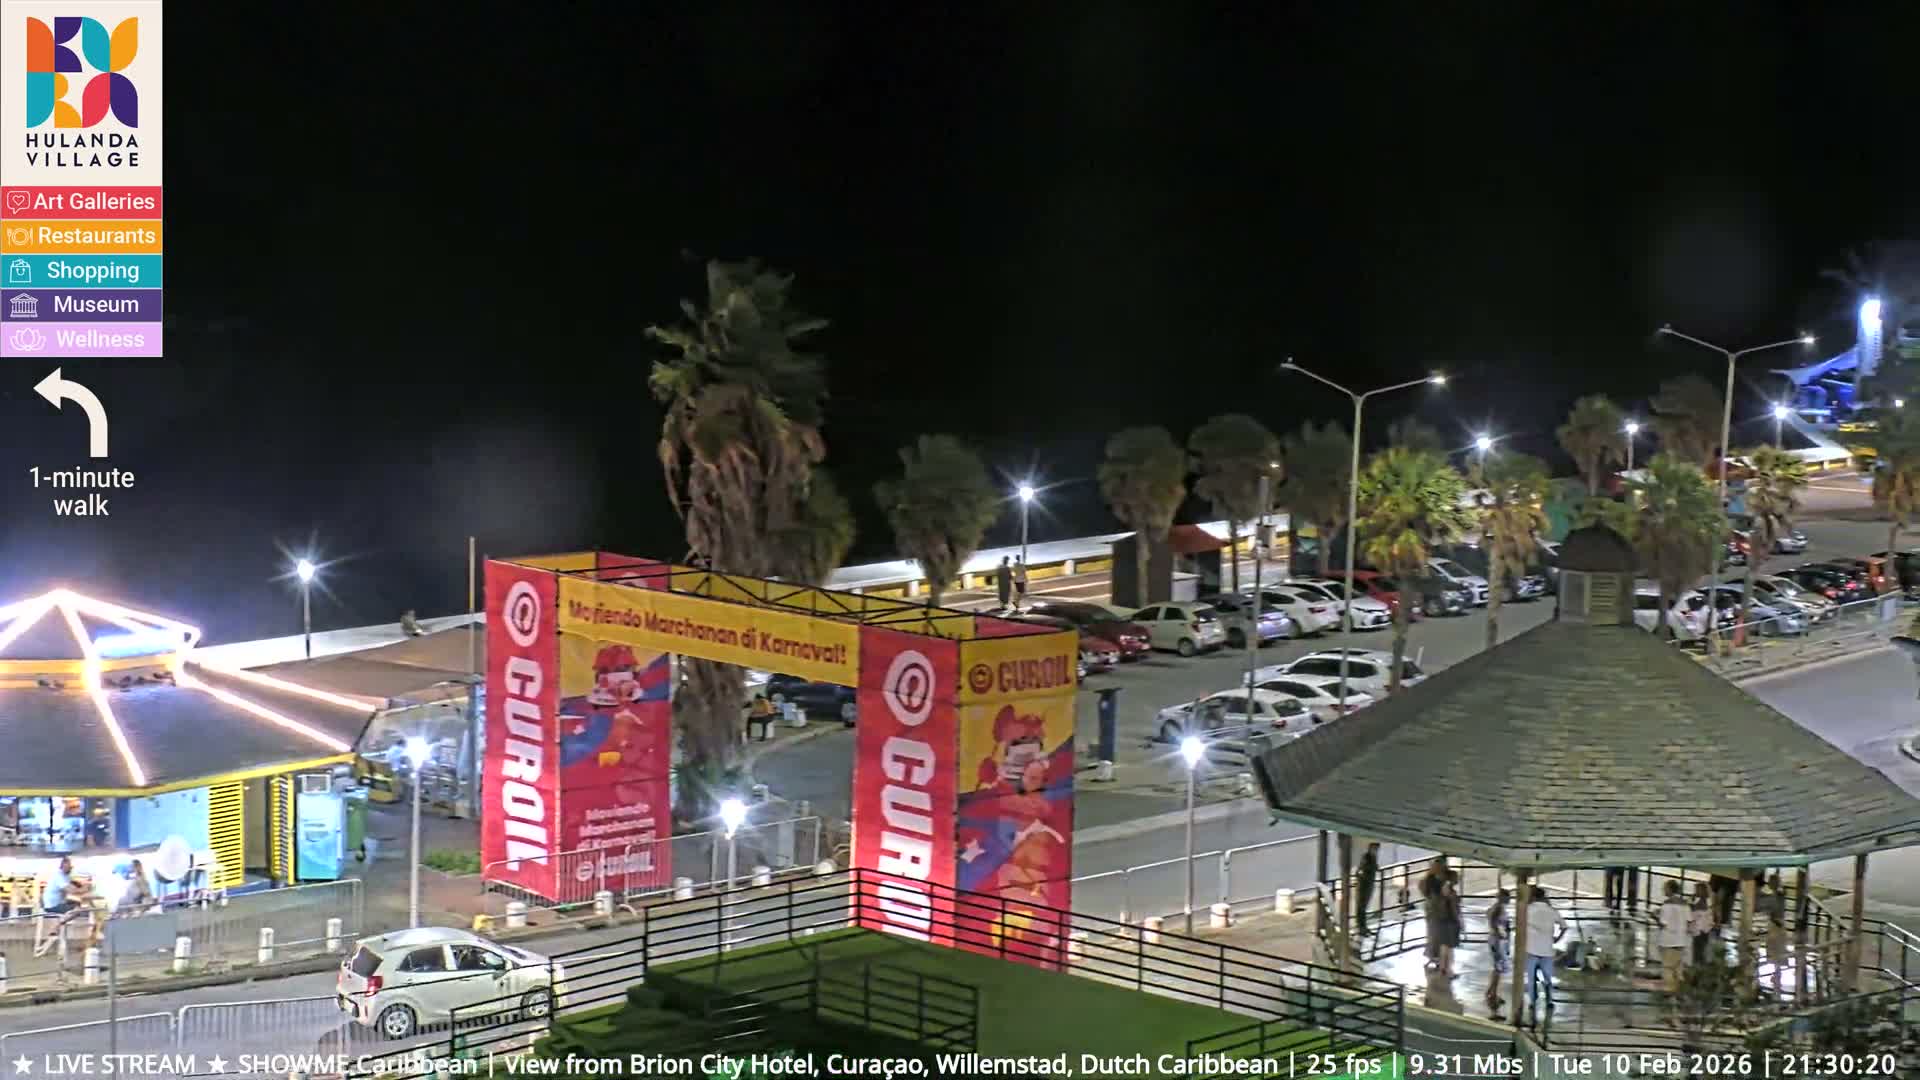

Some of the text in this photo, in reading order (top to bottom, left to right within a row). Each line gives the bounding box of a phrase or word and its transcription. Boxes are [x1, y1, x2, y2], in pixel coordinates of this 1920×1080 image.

[643, 611, 738, 645] Marchanan
[741, 627, 756, 651] di
[760, 631, 846, 665] Karnaval!
[998, 653, 1072, 692] CUROIL
[502, 656, 549, 872] CUROIL
